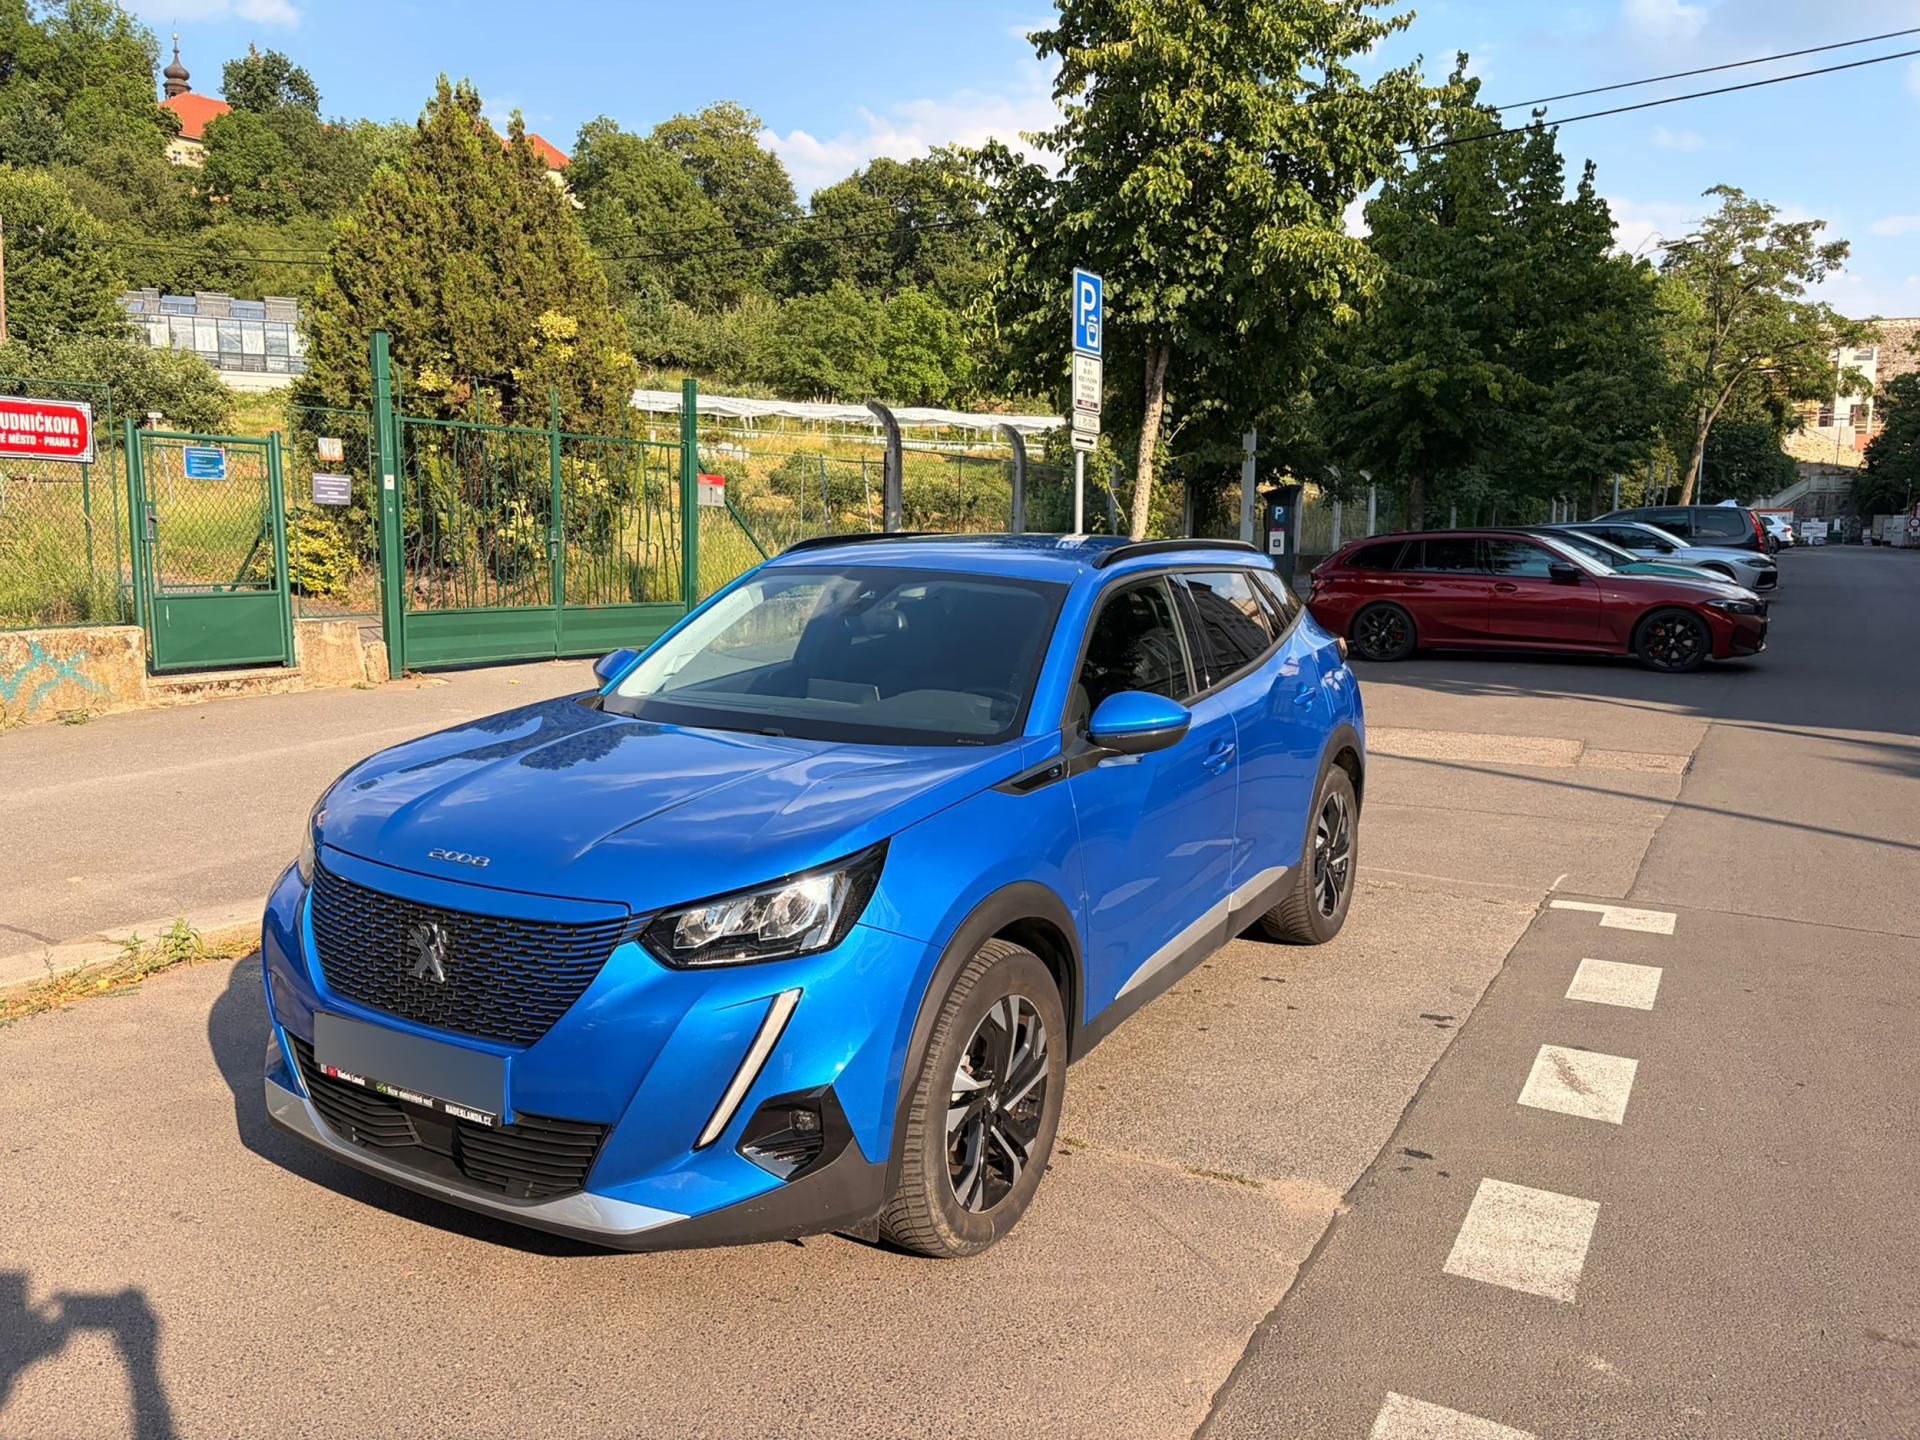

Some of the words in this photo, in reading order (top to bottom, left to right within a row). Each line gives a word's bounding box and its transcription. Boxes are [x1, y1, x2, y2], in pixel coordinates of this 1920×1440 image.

[1080, 280, 1097, 326] P
[8, 432, 37, 446] MĚSTO
[44, 436, 71, 448] PRAHA
[72, 438, 79, 449] 2
[428, 847, 491, 867] 2008
